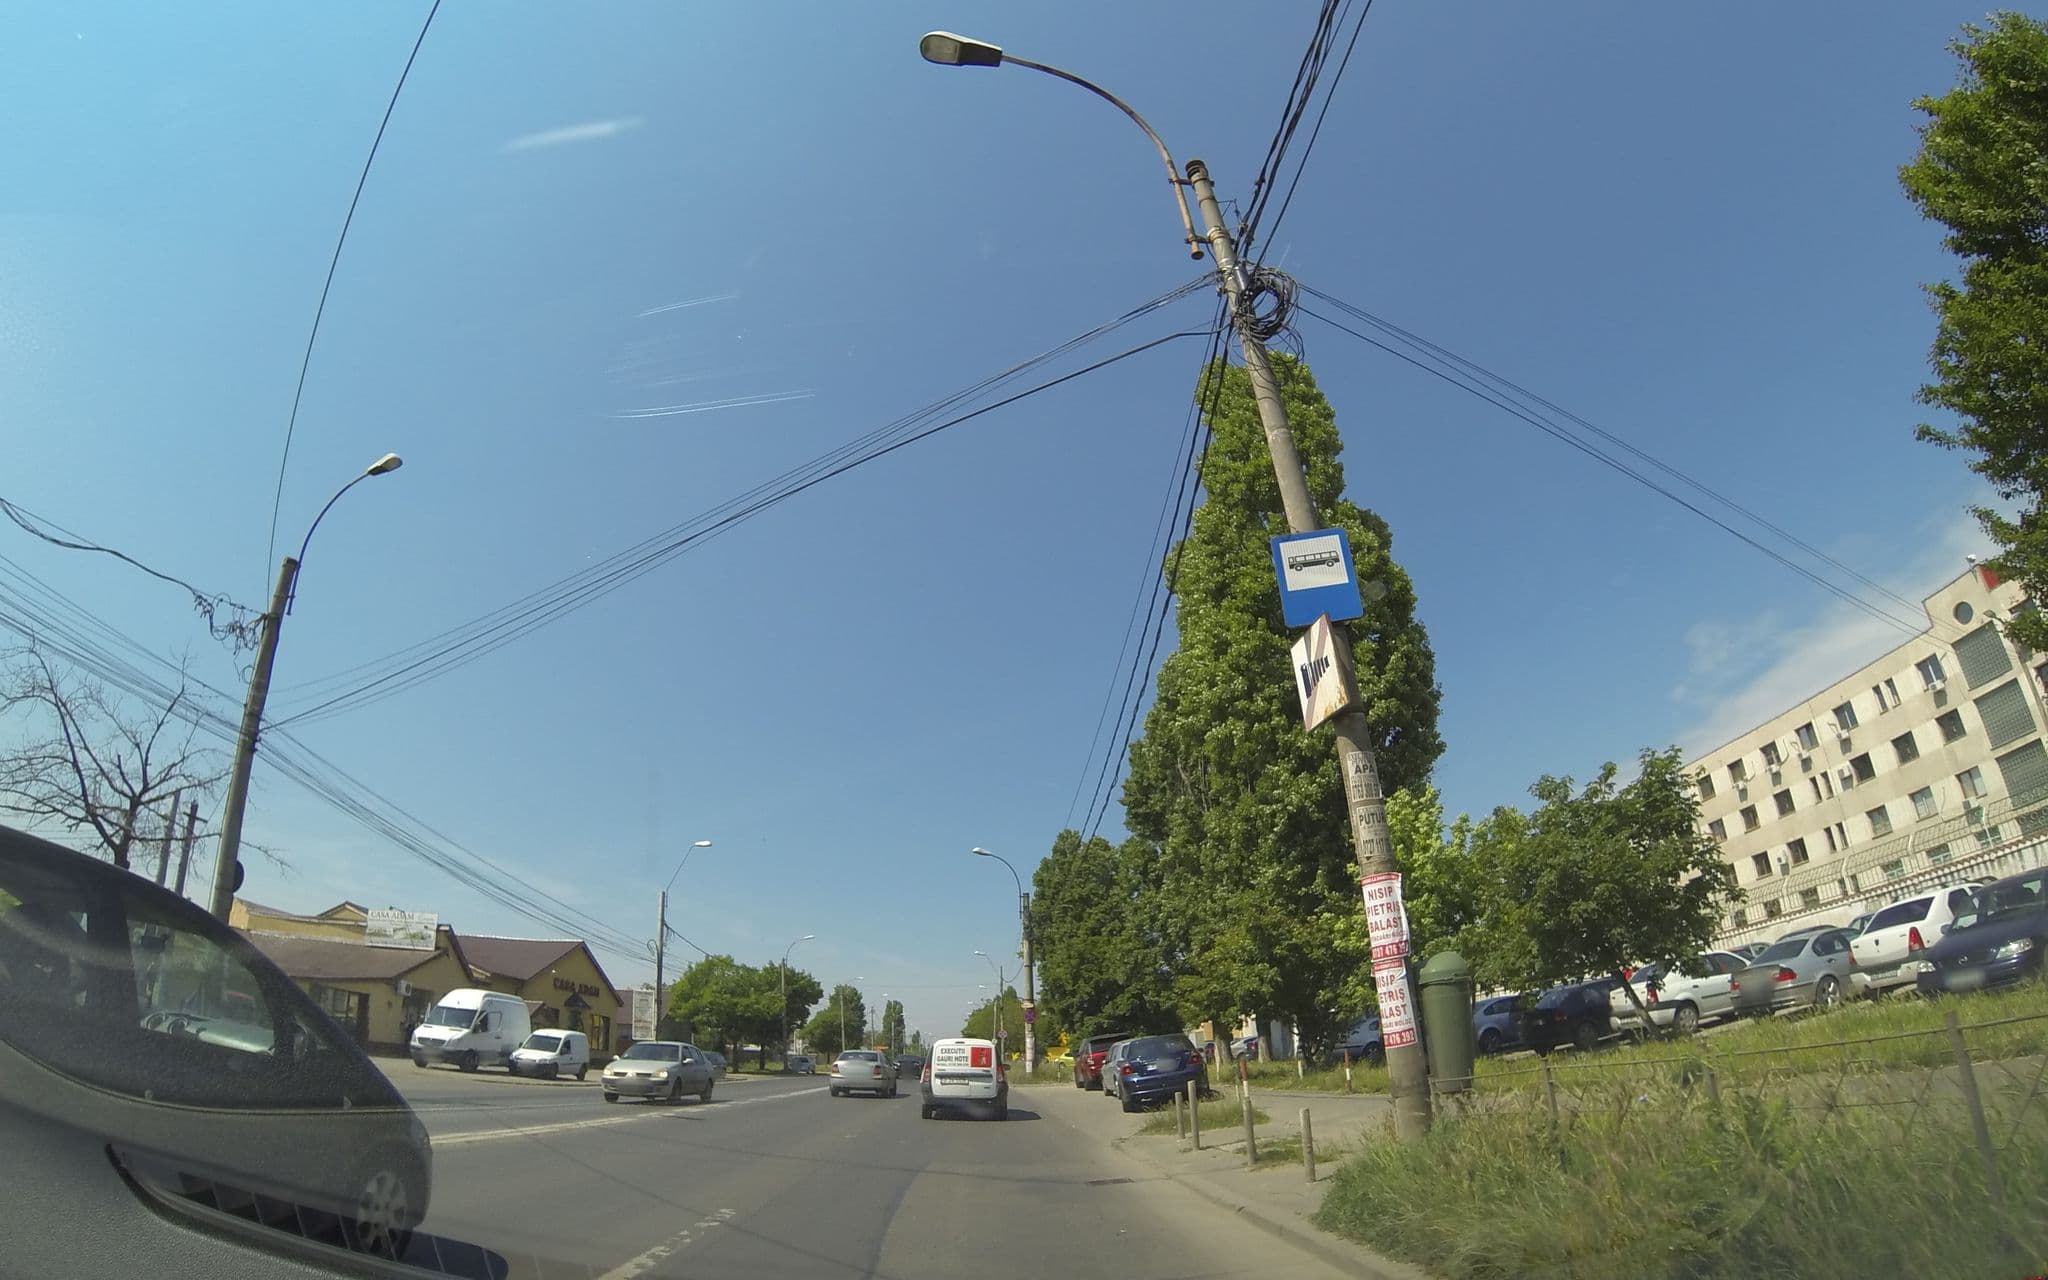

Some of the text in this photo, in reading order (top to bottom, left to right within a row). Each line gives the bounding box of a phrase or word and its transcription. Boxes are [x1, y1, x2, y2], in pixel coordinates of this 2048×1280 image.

[1355, 764, 1376, 774] APA
[1368, 886, 1393, 901] NISIP
[1370, 916, 1402, 933] BALAST
